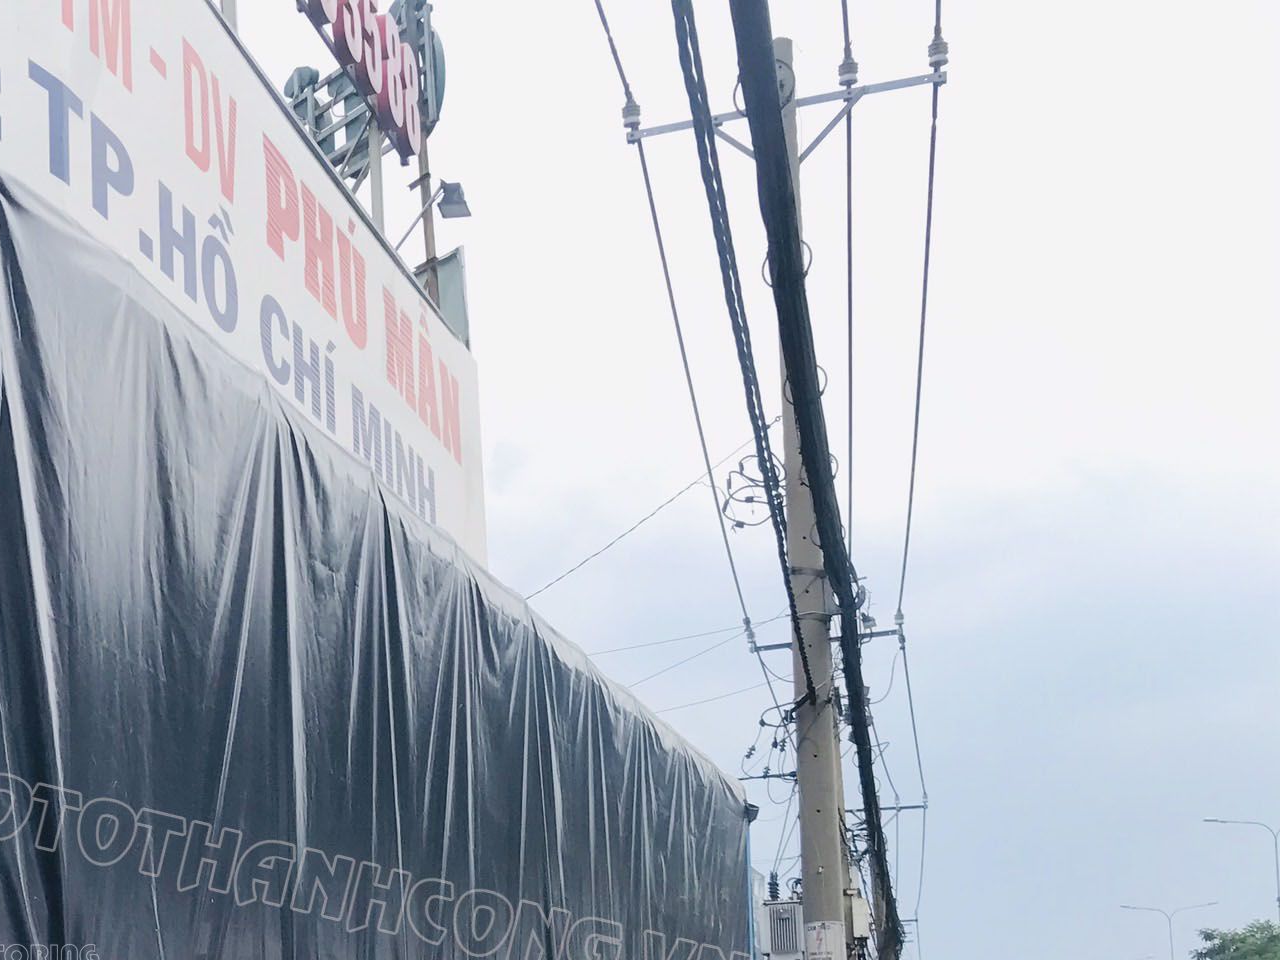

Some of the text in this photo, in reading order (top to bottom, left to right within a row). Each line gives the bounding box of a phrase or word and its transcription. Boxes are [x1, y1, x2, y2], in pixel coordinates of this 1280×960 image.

[182, 35, 237, 206] DV
[262, 131, 368, 350] PHÚ
[260, 293, 337, 436] CHÍ
[351, 383, 437, 526] MINH
